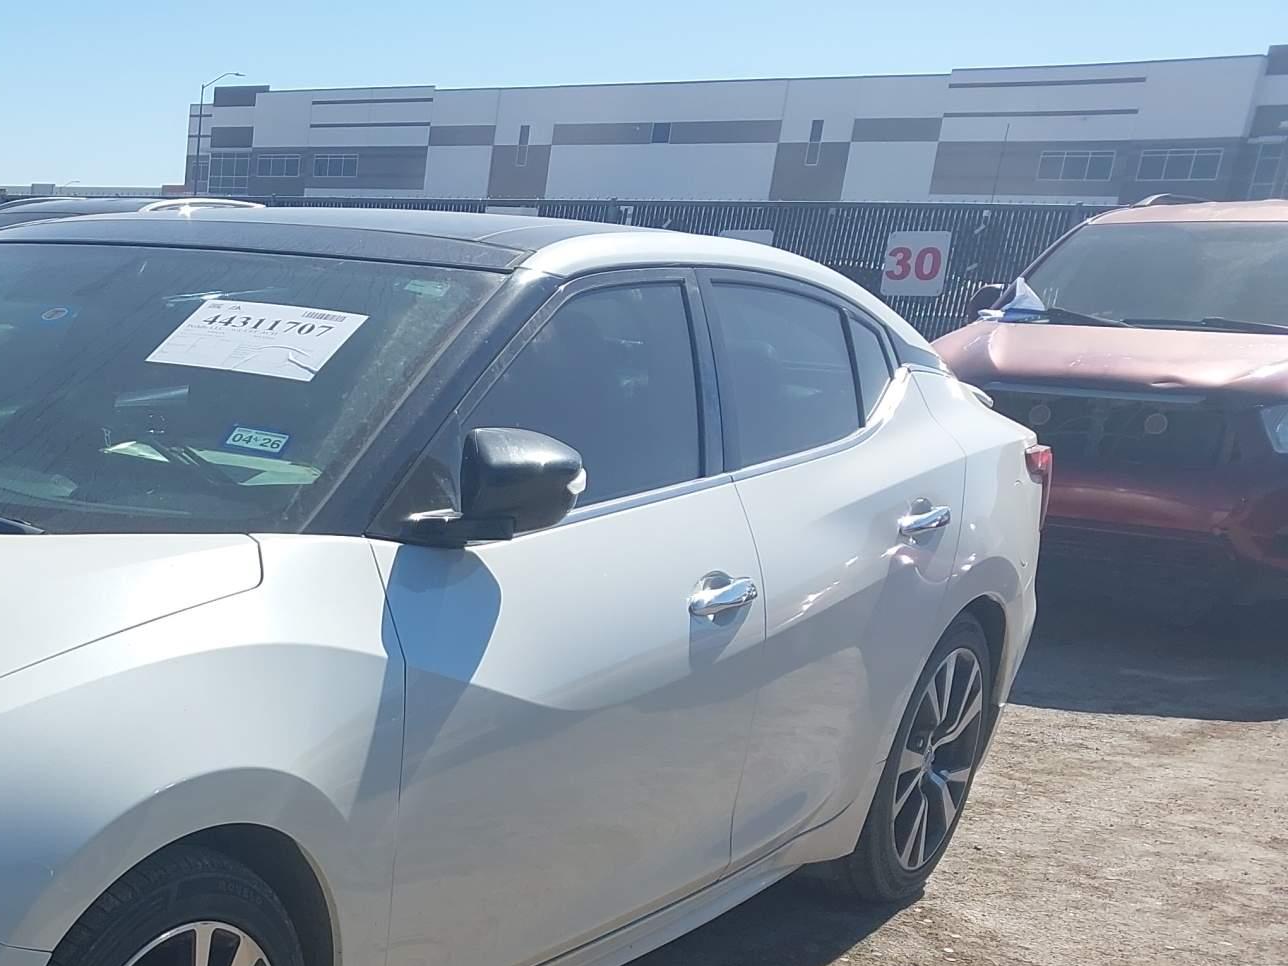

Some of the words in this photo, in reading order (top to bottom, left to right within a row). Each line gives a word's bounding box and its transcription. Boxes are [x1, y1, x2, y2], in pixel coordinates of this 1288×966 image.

[884, 246, 942, 281] 30
[202, 313, 335, 338] 44311707
[231, 433, 253, 445] 04
[259, 437, 283, 449] 26
